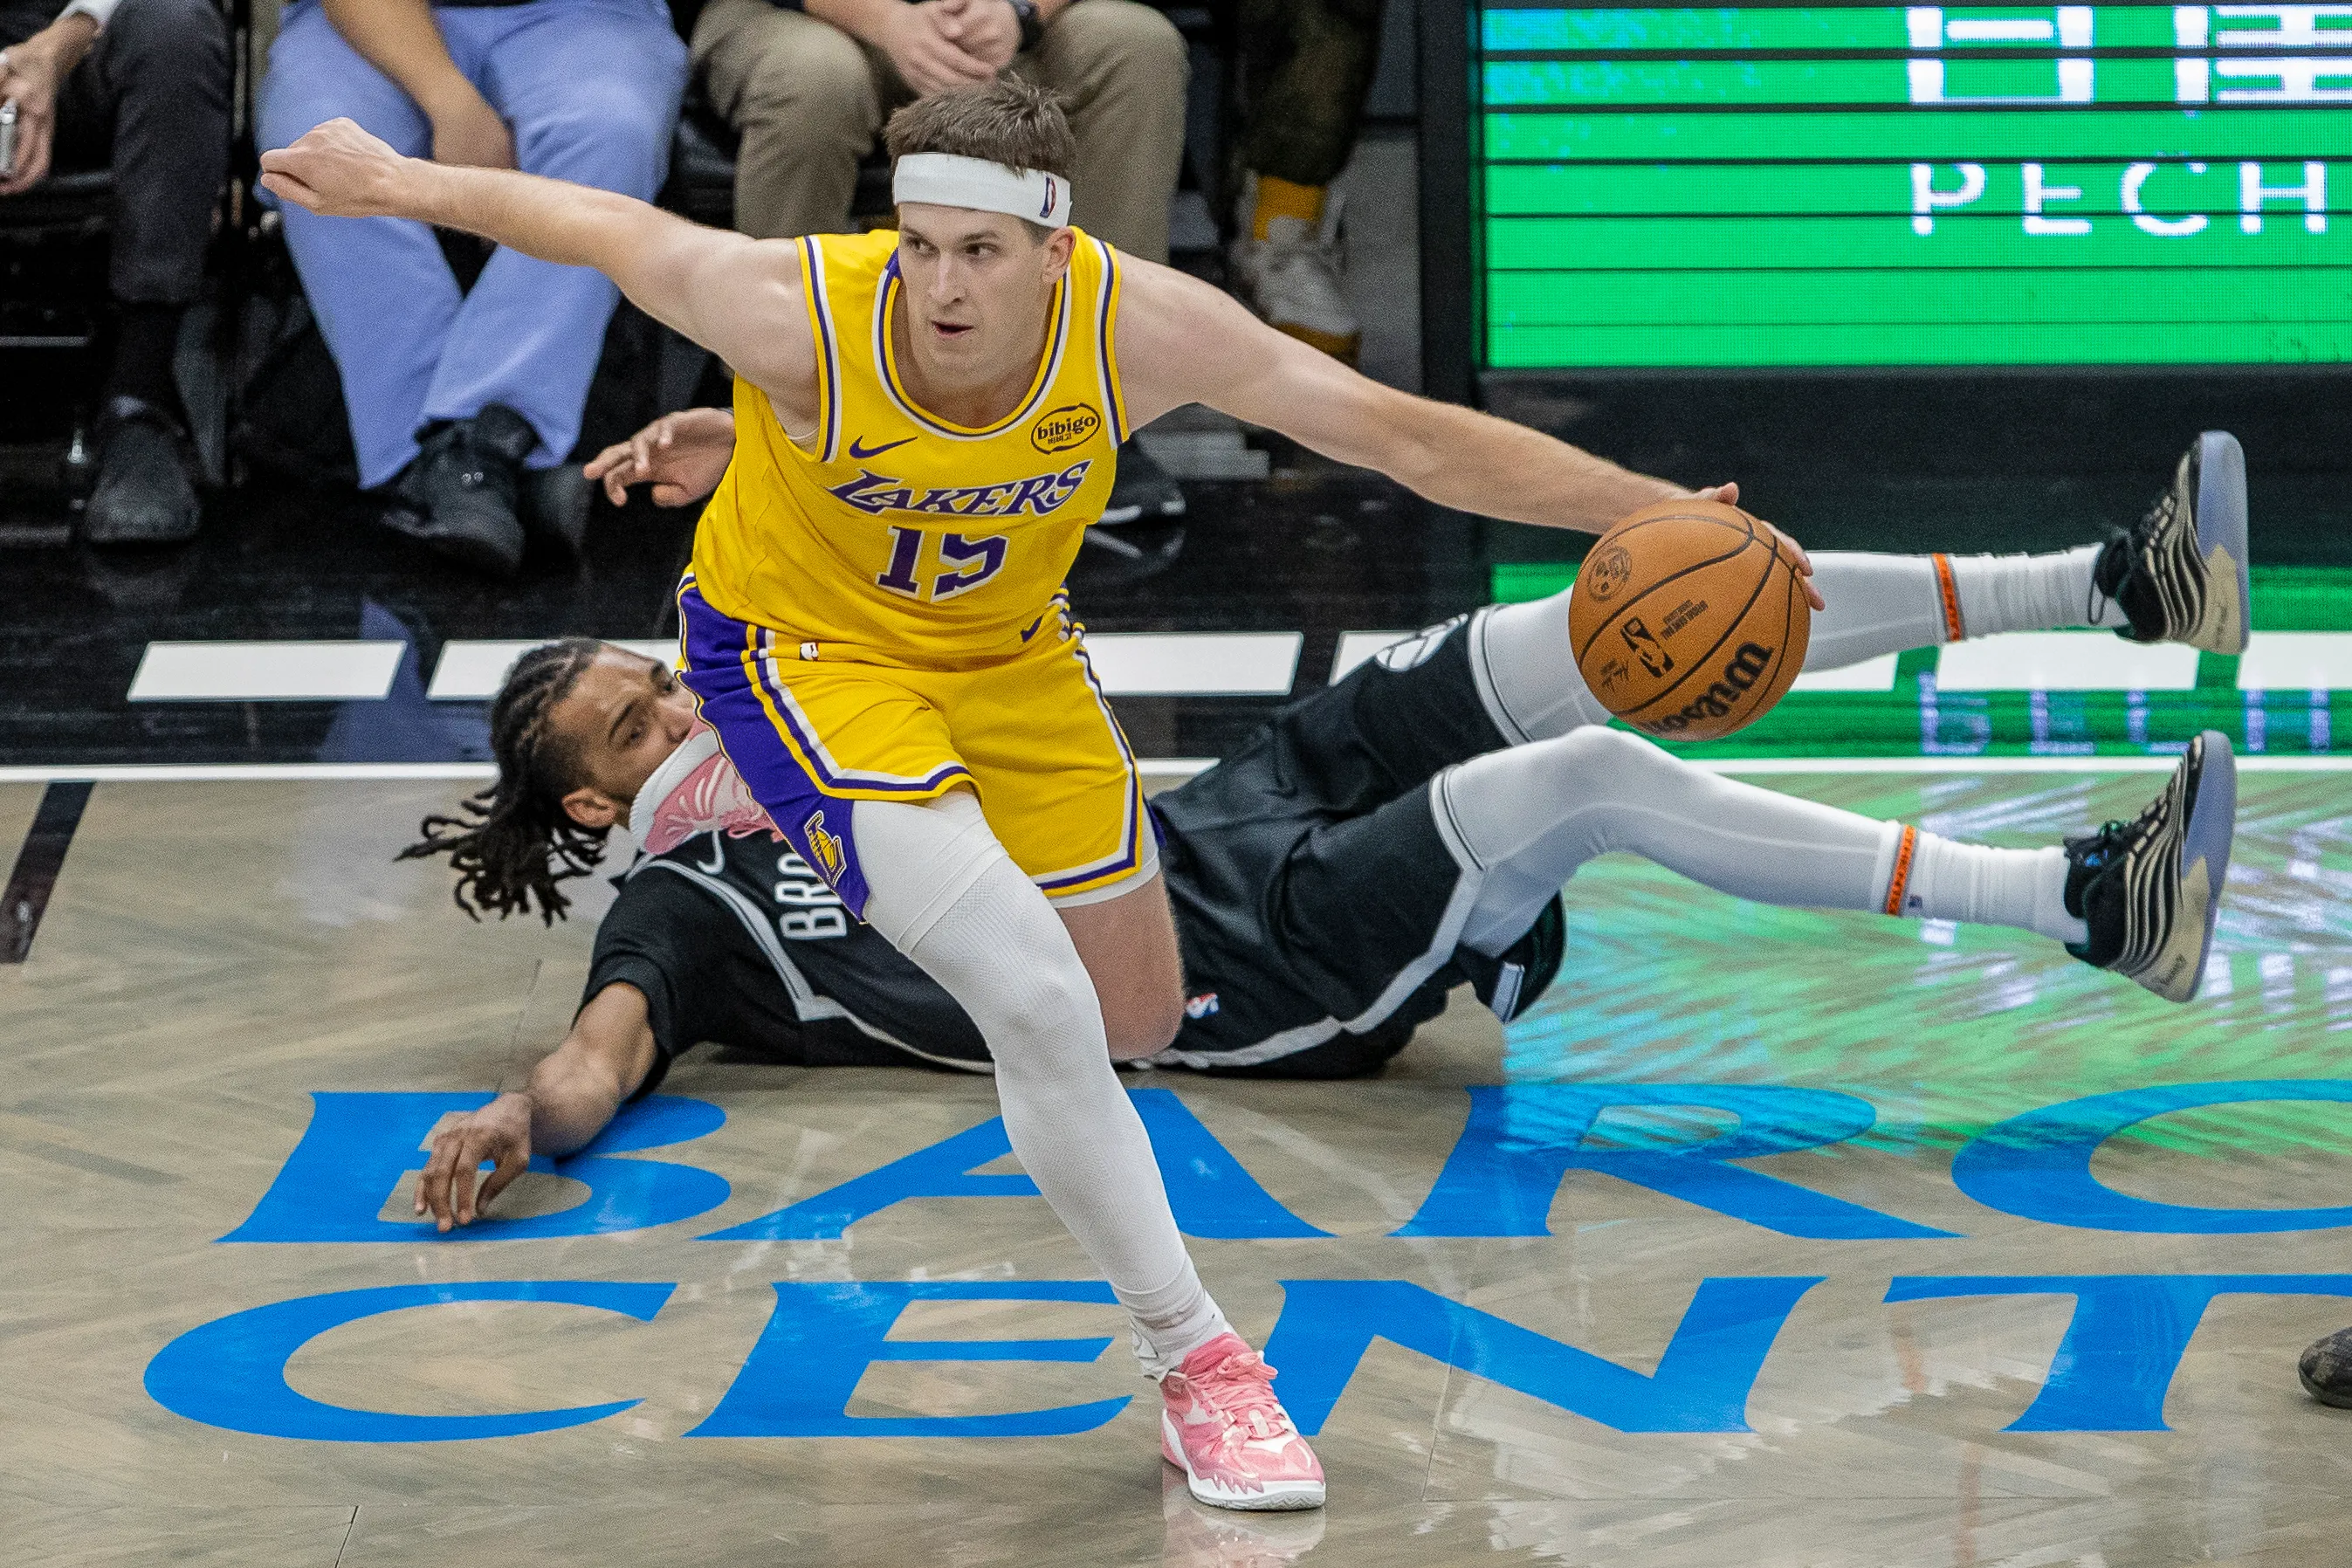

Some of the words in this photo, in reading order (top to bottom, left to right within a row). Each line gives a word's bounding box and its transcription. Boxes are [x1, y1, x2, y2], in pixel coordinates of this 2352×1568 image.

[1910, 161, 2328, 237] PECH
[1037, 416, 1096, 440] bibigo
[828, 459, 1094, 516] LAKERS
[875, 525, 1010, 603] 15
[214, 1079, 2352, 1243] BARC
[144, 1275, 2352, 1441] CENT
